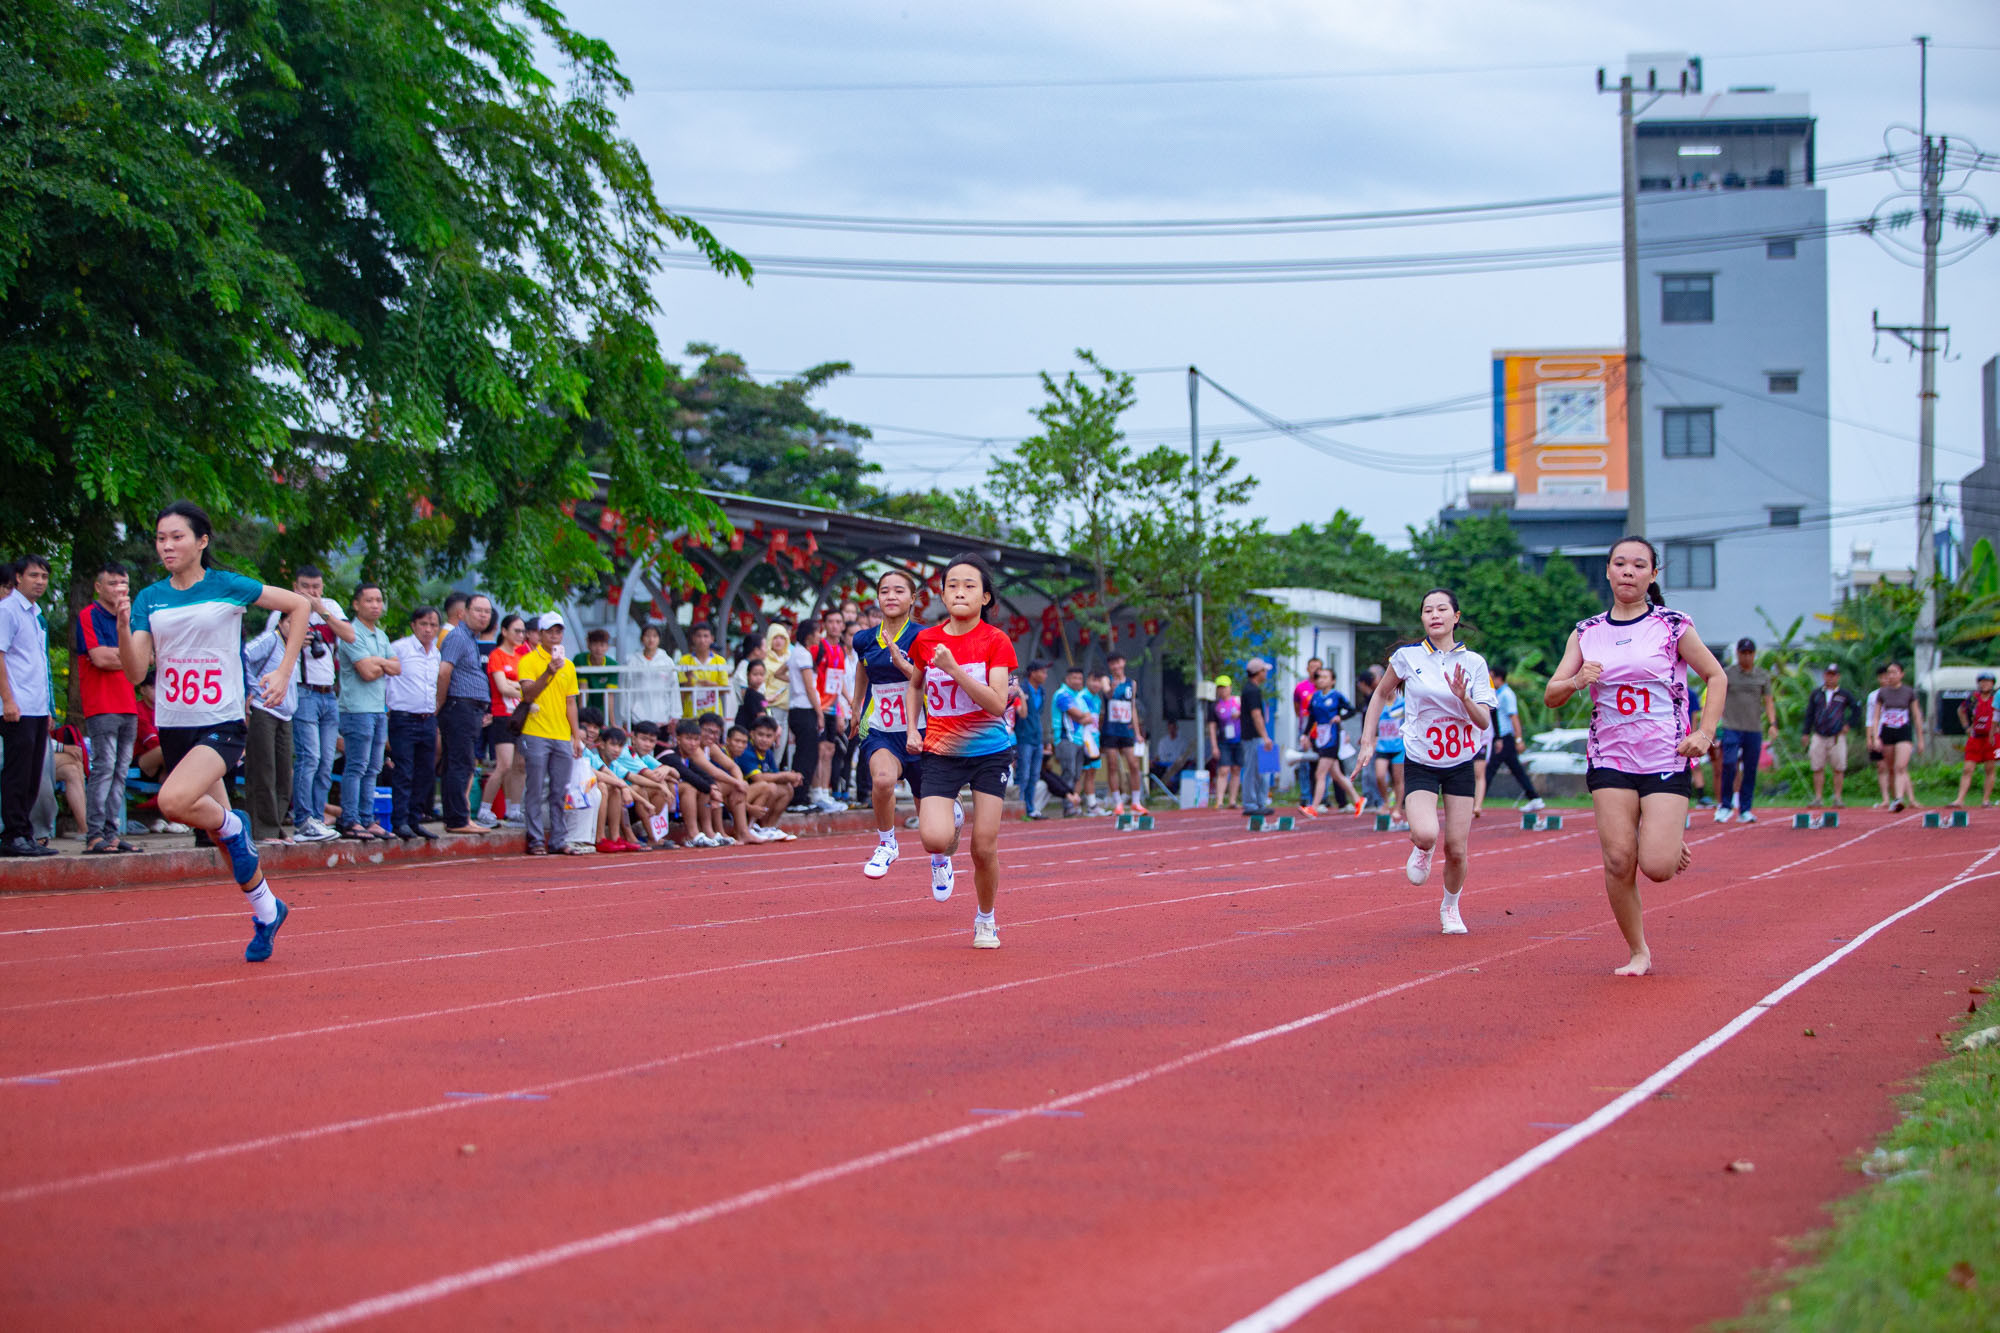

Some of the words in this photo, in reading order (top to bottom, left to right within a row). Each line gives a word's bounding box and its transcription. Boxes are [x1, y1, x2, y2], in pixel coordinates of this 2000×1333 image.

[165, 667, 222, 705] 365
[1616, 685, 1651, 716] 61
[880, 694, 907, 728] 81
[1426, 724, 1475, 761] 384
[654, 816, 668, 834] 94
